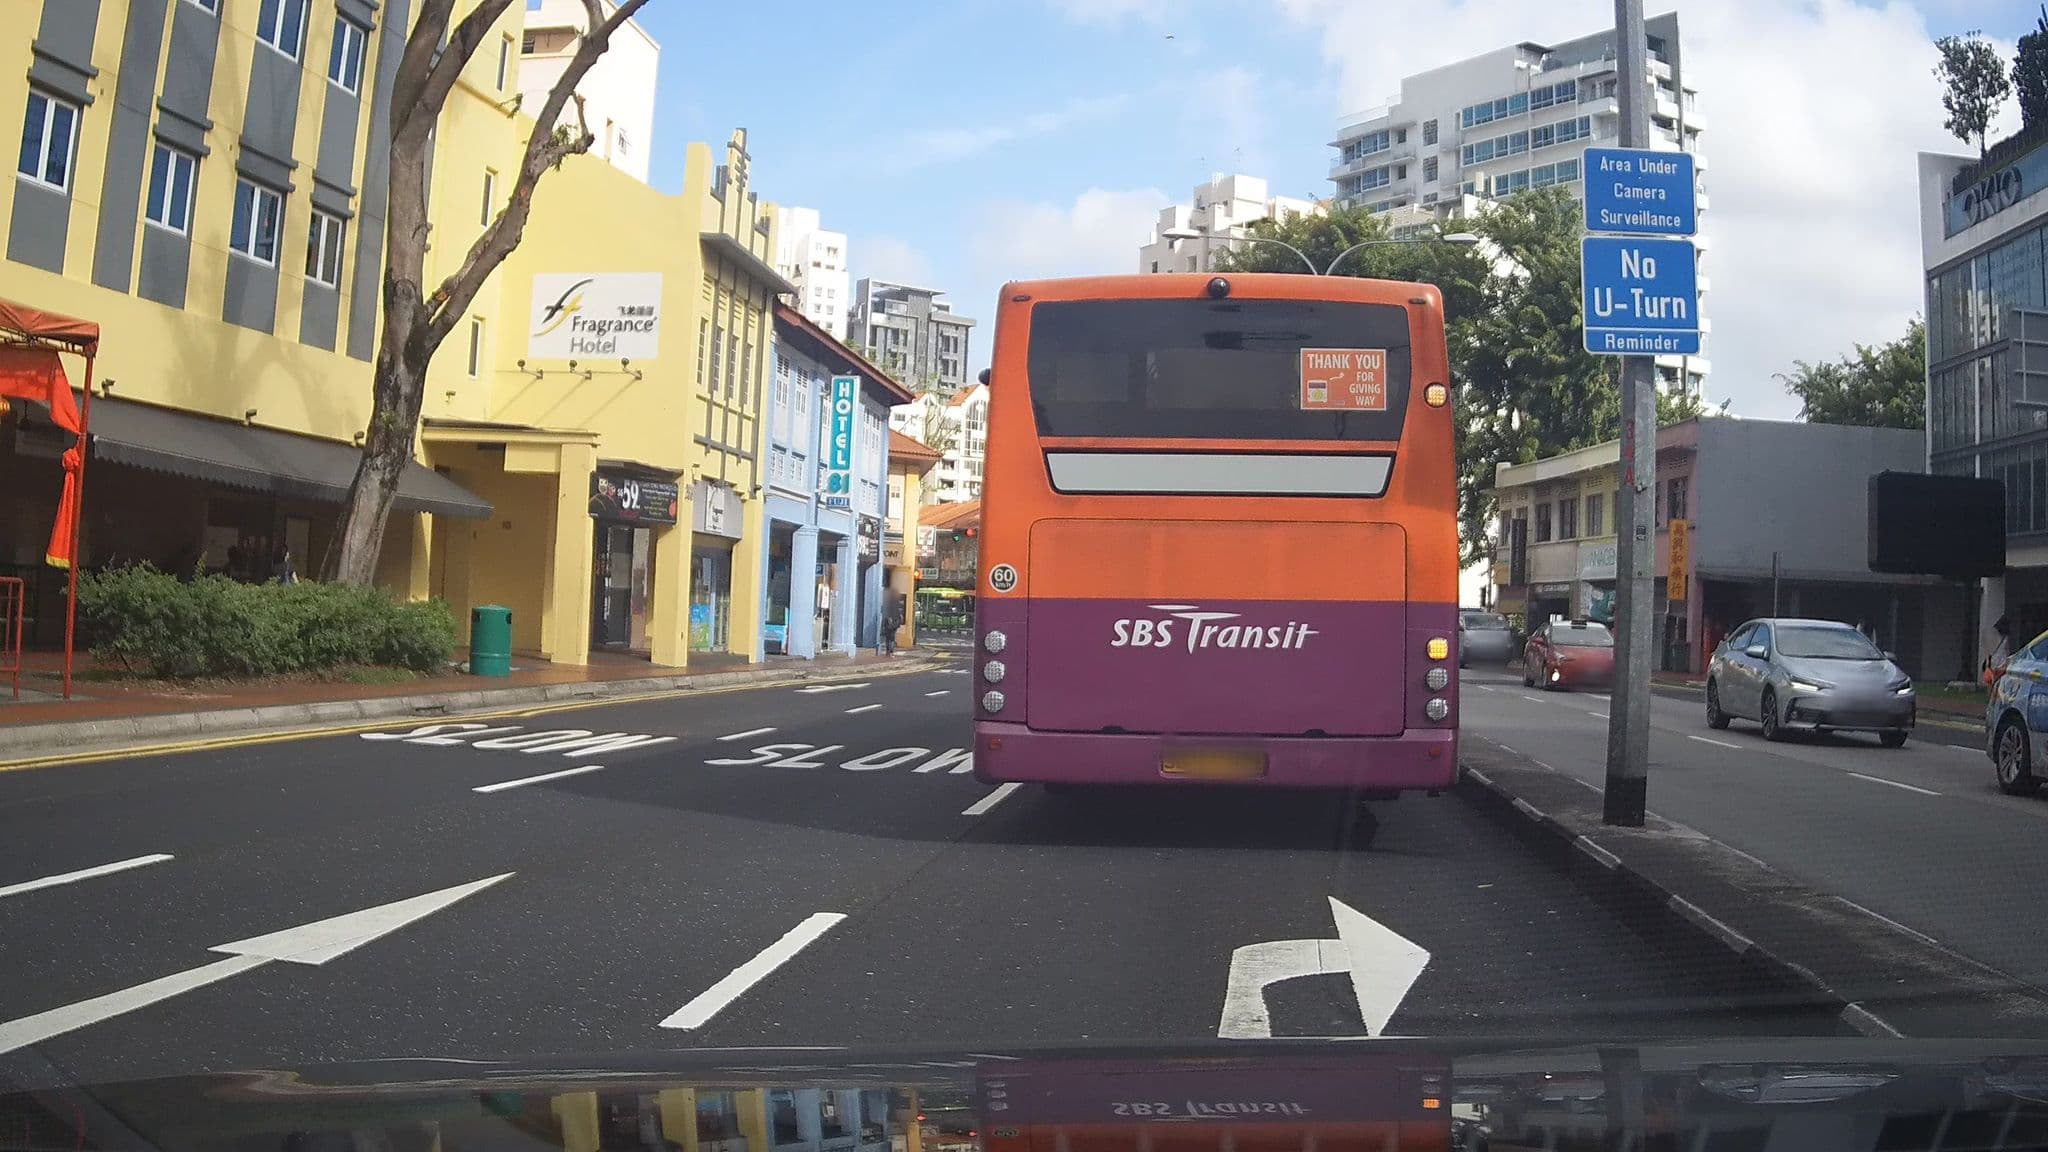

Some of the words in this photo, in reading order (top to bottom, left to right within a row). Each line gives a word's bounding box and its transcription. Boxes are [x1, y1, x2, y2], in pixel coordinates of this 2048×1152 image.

[1600, 156, 1631, 172] Area
[1639, 158, 1677, 174] Under
[1613, 182, 1666, 200] Camera
[1600, 208, 1681, 227] Surveillance
[1620, 248, 1656, 279] No
[1593, 287, 1686, 319] U-Turn
[571, 315, 654, 336] Fragrance
[570, 336, 617, 353] Hotel
[1605, 333, 1680, 350] Reminder
[1307, 353, 1350, 369] THANK
[1355, 354, 1380, 369] YOU
[1356, 371, 1374, 382] FOR
[1349, 384, 1381, 394] GIVING
[1355, 395, 1376, 406] WAY
[835, 381, 851, 466] HOTEL
[994, 568, 1013, 582] 60
[1111, 619, 1173, 647] SBS
[1170, 612, 1320, 654] Transit
[360, 724, 678, 757] SLOW
